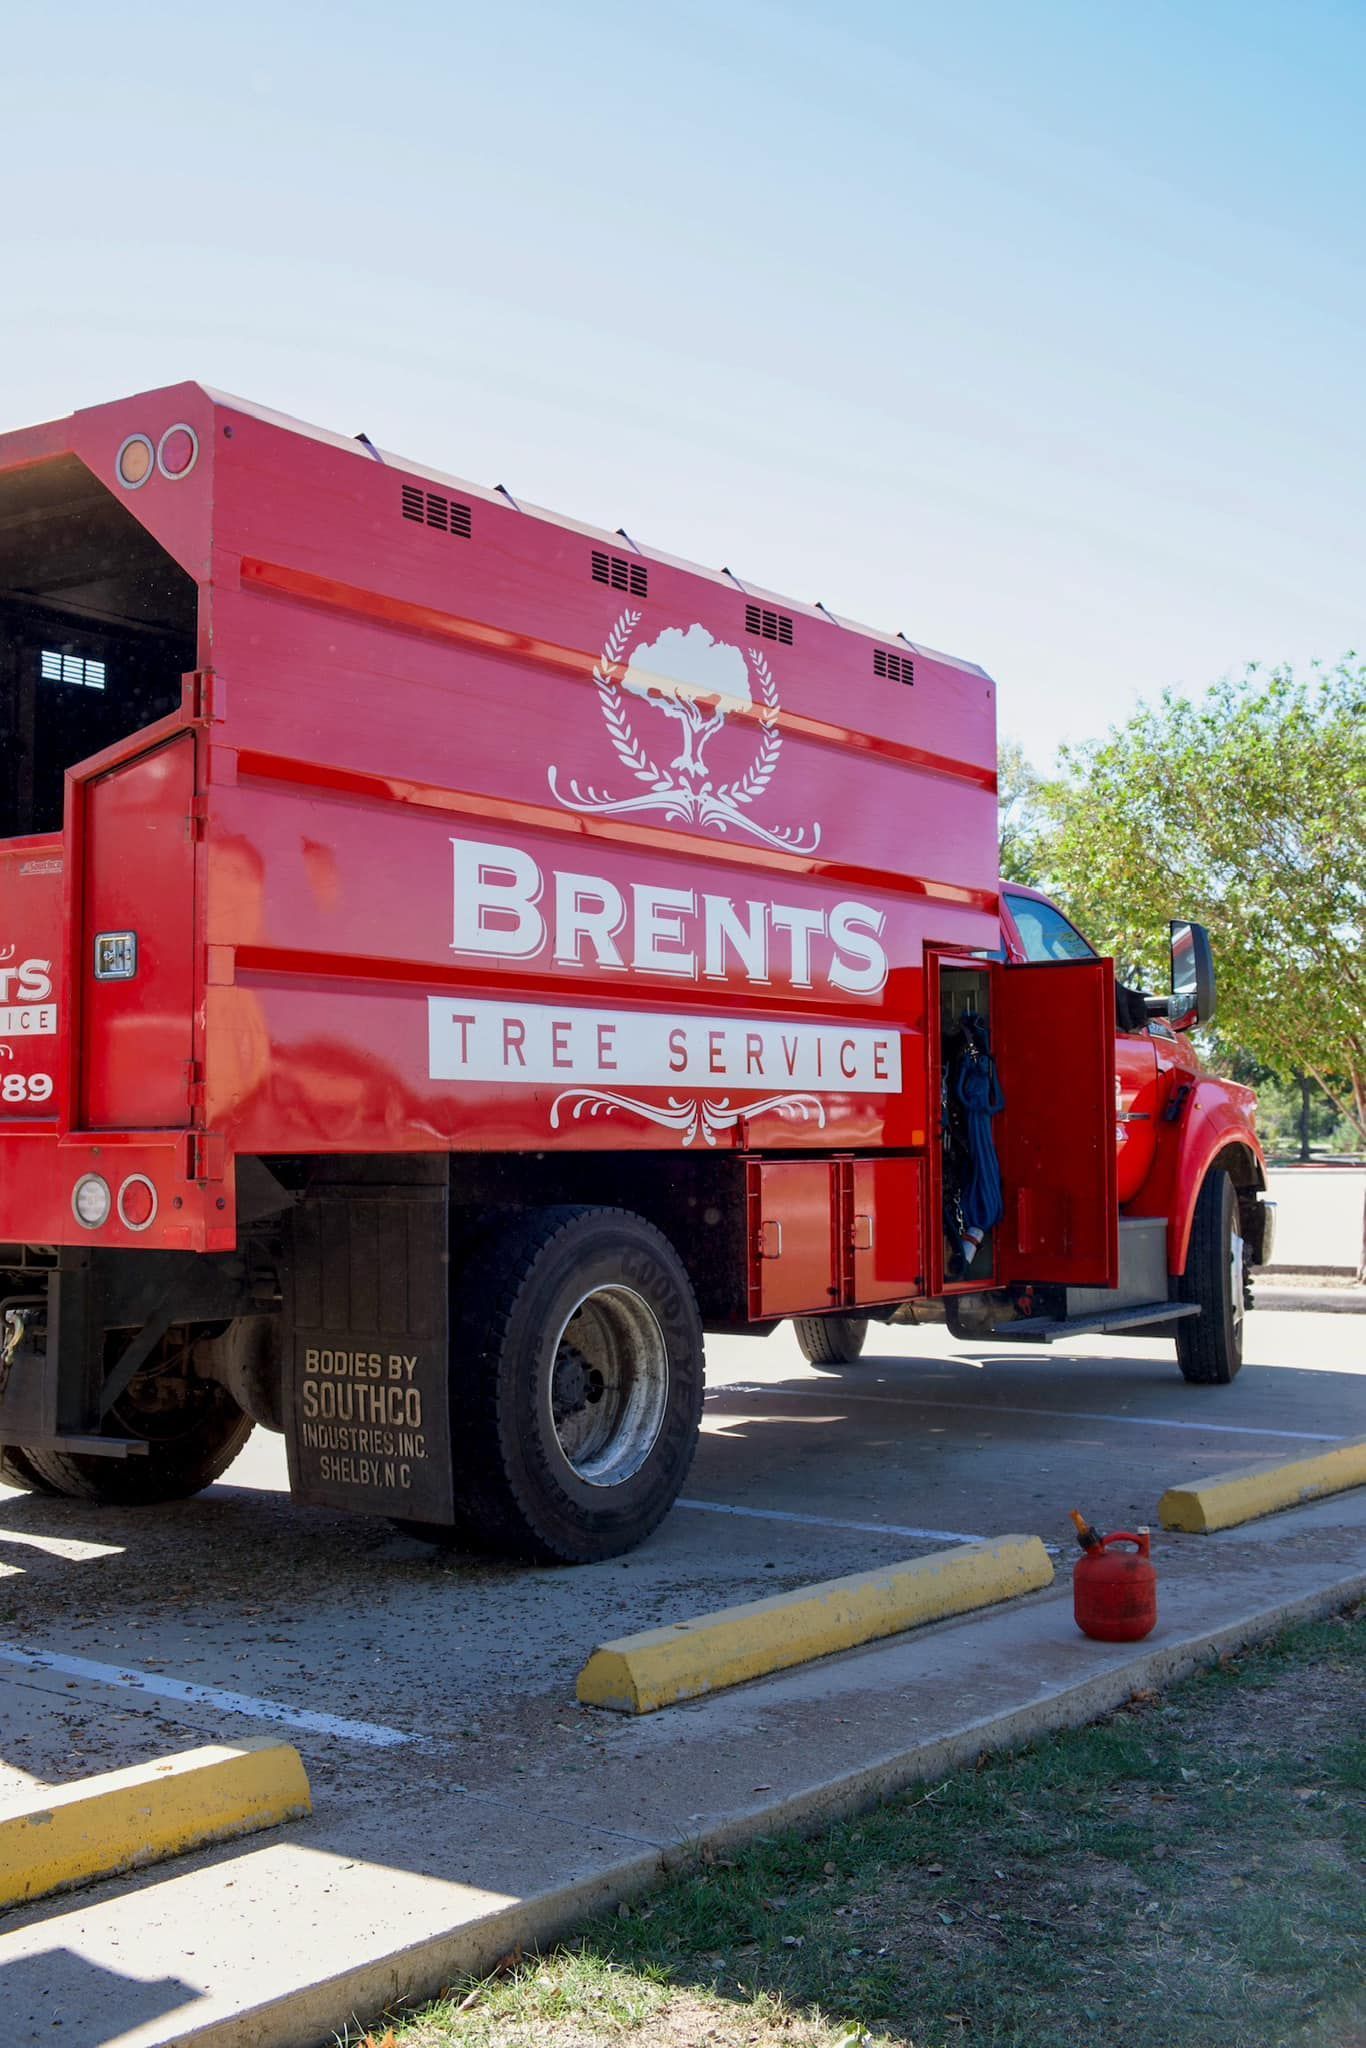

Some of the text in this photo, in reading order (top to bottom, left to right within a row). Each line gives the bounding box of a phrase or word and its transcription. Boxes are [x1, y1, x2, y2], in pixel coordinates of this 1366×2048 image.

[449, 838, 889, 995] BRENTS
[452, 1015, 889, 1080] TREE SERVICE
[0, 1073, 53, 1102] 89
[305, 1349, 418, 1381] BODIES BY
[303, 1381, 421, 1428] SOUTHCO
